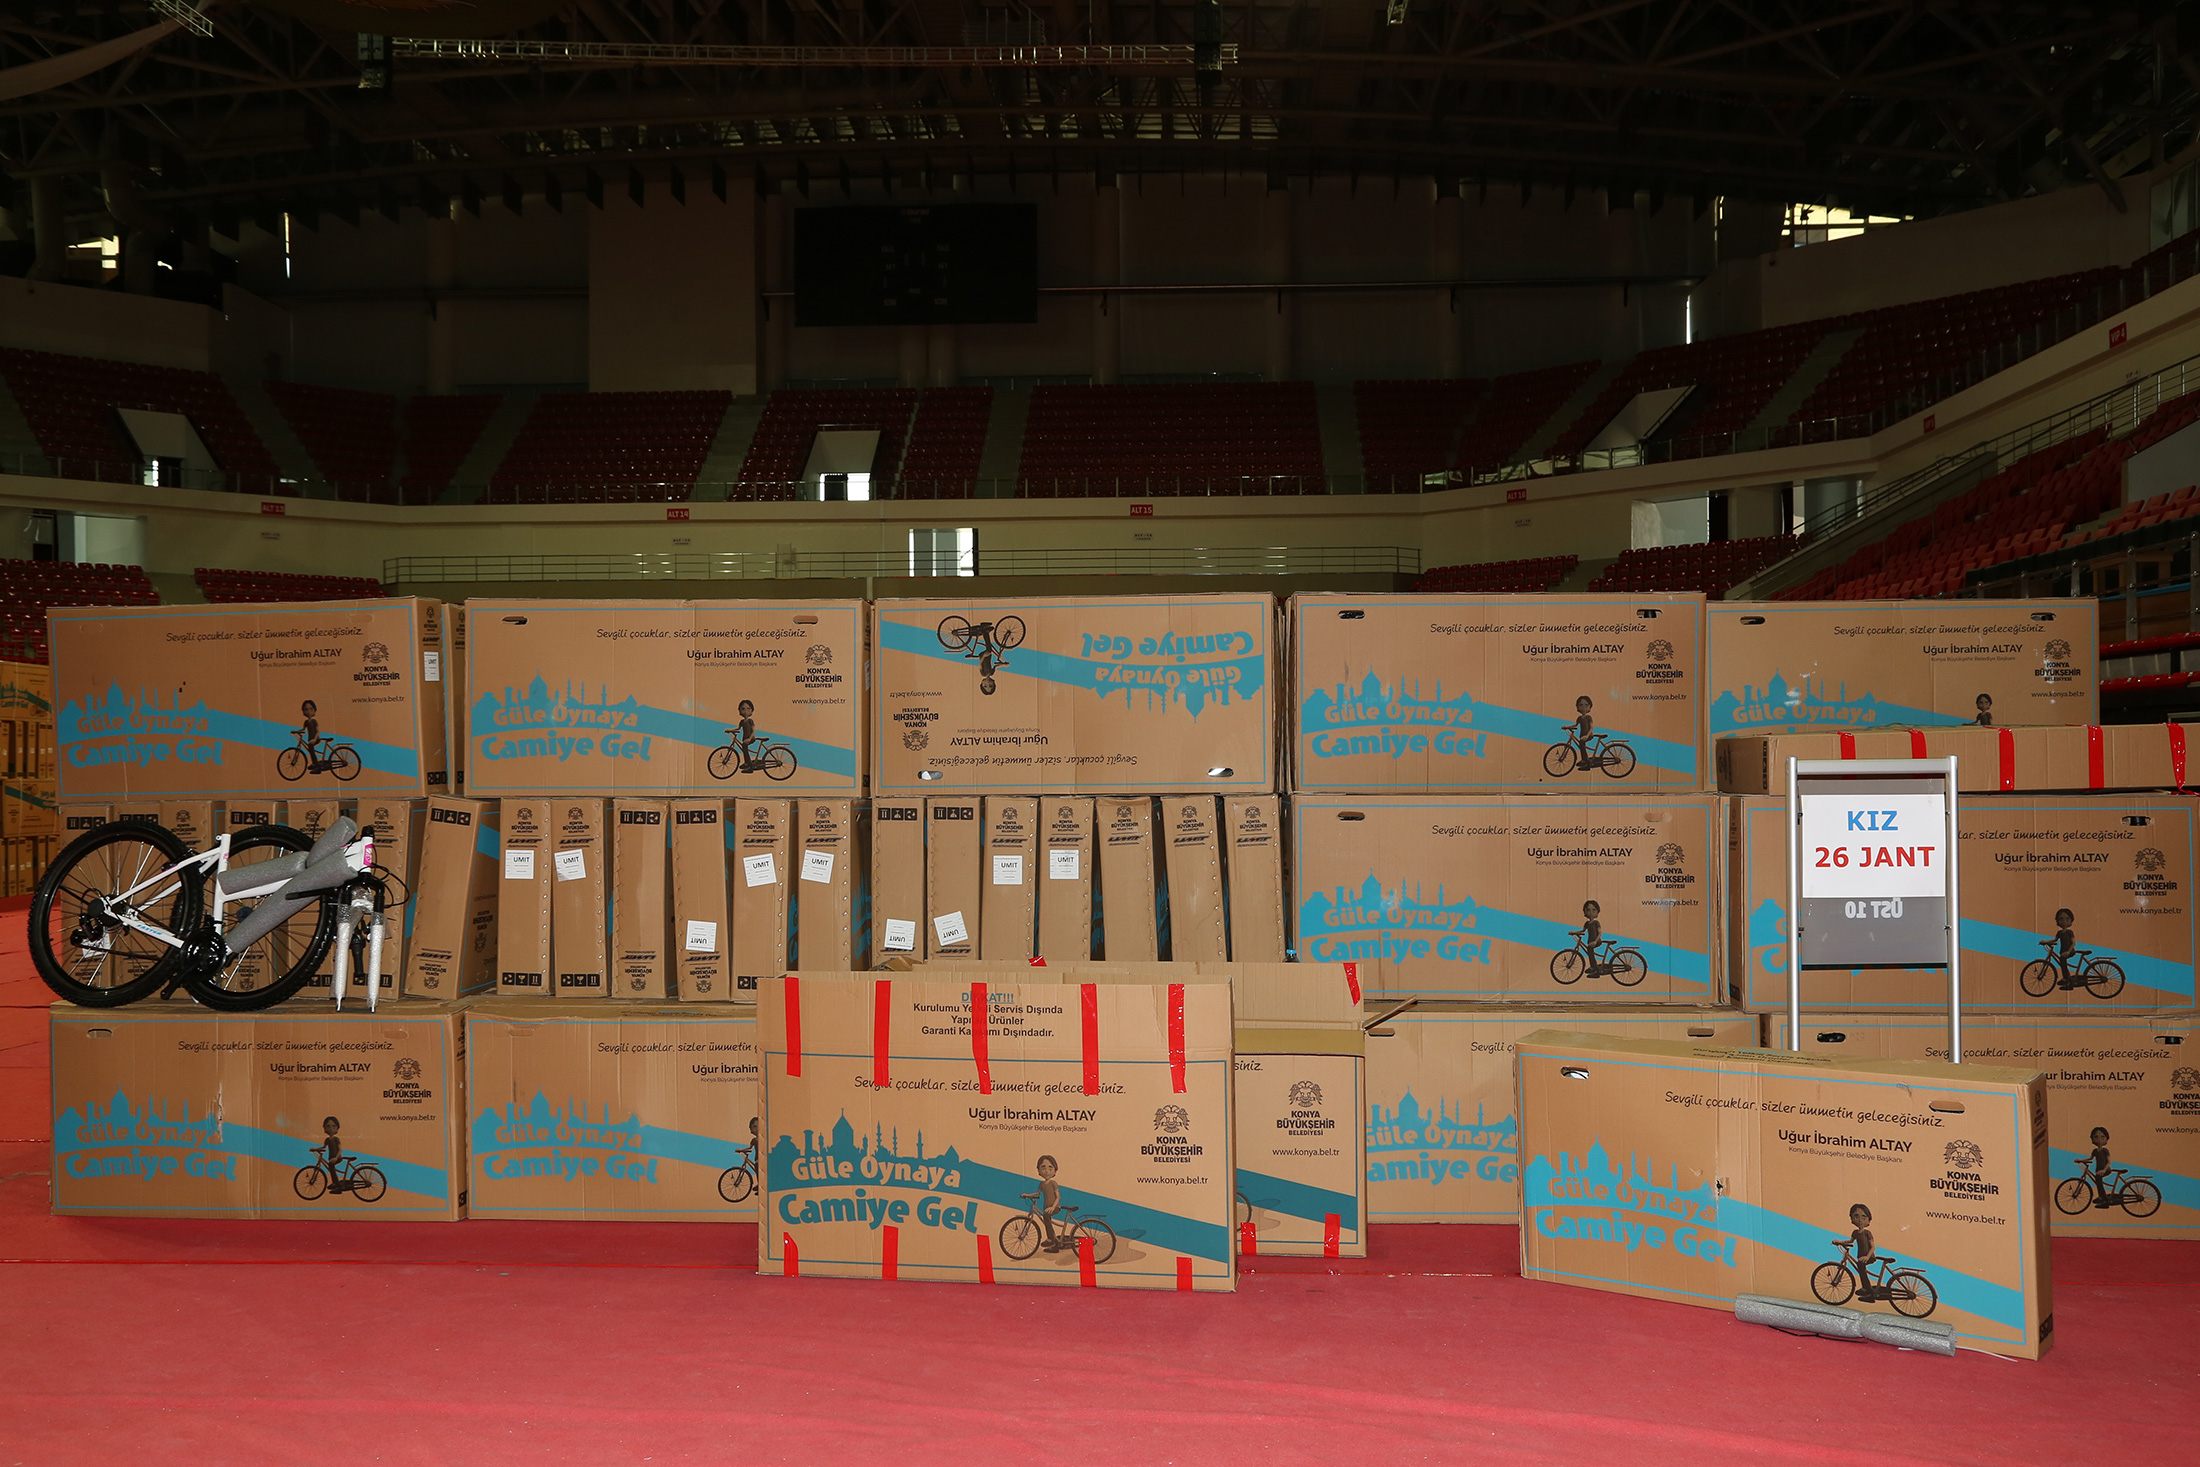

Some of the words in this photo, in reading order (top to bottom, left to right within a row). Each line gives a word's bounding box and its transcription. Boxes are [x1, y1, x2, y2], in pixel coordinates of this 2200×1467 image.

[668, 510, 679, 518] ALT
[1131, 506, 1142, 514] ALT
[1143, 506, 1152, 514] 15
[1431, 624, 1462, 634] Sevgili
[1464, 624, 1506, 635] çocuklar.
[1509, 624, 1537, 633] sizler
[1539, 624, 1581, 633] ümmetin
[1584, 624, 1648, 635] geleceğisiniz.
[1080, 631, 1132, 660] Gel
[1138, 629, 1253, 663] Camiye
[1522, 645, 1548, 655] Uğur
[1550, 643, 1590, 654] İbrahim
[1593, 645, 1624, 654] ALTAY
[1923, 645, 1948, 655] Uğur
[1950, 643, 1989, 654] İbrahim
[1992, 644, 2023, 653] ALTAY
[250, 650, 274, 661] Uğur
[275, 647, 312, 659] İbrahim
[314, 648, 343, 658] ALTAY
[686, 649, 711, 659] Uğur
[713, 648, 751, 658] İbrahim
[754, 650, 784, 658] ALTAY
[796, 674, 842, 683] BÜYÜKŞEHİR
[1094, 664, 1180, 689] Oynaya
[1186, 665, 1241, 687] Güle
[1636, 670, 1683, 679] BÜYÜKŞEHİR
[493, 705, 547, 726] Güle
[552, 705, 638, 728] Oynaya
[893, 712, 938, 721] BÜYÜKŞEHİR
[1325, 702, 1380, 723] Güle
[1386, 702, 1473, 725] Oynaya
[1732, 703, 1786, 723] Güle
[1792, 702, 1876, 723] Oynaya
[77, 713, 124, 733] Güle
[129, 712, 208, 733] Oynaya
[480, 730, 594, 762] Camiye
[600, 733, 652, 761] Gel
[950, 736, 980, 745] ALTAY
[982, 736, 1021, 747] İbrahim
[1023, 735, 1048, 745] Uğur
[1312, 727, 1428, 759] Camiye
[1434, 730, 1487, 758] Gel
[68, 736, 171, 767] Camiye
[176, 739, 223, 765] Gel
[1848, 811, 1898, 830] KIZ
[1527, 847, 1554, 858] Uğur
[1556, 846, 1598, 857] İbrahim
[1600, 848, 1633, 857] ALTAY
[1816, 847, 1849, 867] 26
[1860, 847, 1935, 867] JANT
[1994, 853, 2023, 864] Uğur
[2026, 851, 2071, 863] İbrahim
[2074, 853, 2109, 863] ALTAY
[1645, 874, 1695, 884] BÜYÜKŞEHİR
[2123, 881, 2178, 891] BÜYÜKŞEHİR
[1641, 899, 1698, 907] www.konya.bel.tr
[1324, 905, 1380, 927] Güle
[1387, 905, 1477, 930] Oynaya
[2119, 907, 2182, 916] www.konya.bel.tr
[1310, 930, 1431, 965] Camiye
[1437, 935, 1491, 964] Gel
[914, 1003, 959, 1012] Kurulumu
[994, 1005, 1023, 1014] Servis
[1026, 1005, 1062, 1016] Dışında
[989, 1016, 1024, 1025] Ürünler
[922, 1027, 956, 1036] Garanti
[1003, 1028, 1054, 1037] Dışındadır.
[269, 1063, 295, 1074] Uğur
[297, 1061, 337, 1073] İbrahim
[339, 1063, 371, 1072] ALTAY
[2061, 1069, 2105, 1081] İbrahim
[2109, 1072, 2145, 1081] ALTAY
[896, 1079, 948, 1092] çocuklar.
[951, 1081, 980, 1092] sizle
[990, 1081, 1041, 1093] ümmetin
[968, 1108, 1000, 1122] Uğur
[1003, 1106, 1053, 1121] İbrahim
[1056, 1110, 1096, 1121] ALTAY
[1666, 1091, 1702, 1107] Sevgili
[1706, 1097, 1758, 1111] çocuklar.
[1761, 1101, 1796, 1114] sizler
[1799, 1104, 1853, 1119] ümmetin
[1857, 1110, 1945, 1128] geleceğisiniz.
[979, 1123, 997, 1131] Konya
[999, 1123, 1033, 1132] Büyükşehir
[1276, 1120, 1335, 1130] BÜYÜKŞEHİR
[76, 1123, 129, 1143] Güle
[135, 1122, 221, 1147] Oynaya
[495, 1125, 550, 1144] Güle
[556, 1123, 642, 1149] Oynaya
[1156, 1136, 1187, 1144] KONYA
[1425, 1125, 1517, 1150] Oynaya
[1779, 1130, 1810, 1144] Uğur
[1814, 1131, 1866, 1148] İbrahim
[1870, 1138, 1912, 1153] ALTAY
[1141, 1145, 1203, 1156] BÜYÜKŞEHİR
[1273, 1148, 1340, 1156] www.konya.bel.tr
[65, 1148, 178, 1181] Camiye
[184, 1152, 237, 1181] Gel
[483, 1149, 600, 1182] Camiye
[605, 1155, 658, 1184] Gel
[1367, 1152, 1469, 1185] amiye
[1476, 1156, 1518, 1183] Ge
[791, 1156, 853, 1180] Güle
[860, 1155, 961, 1190] Oynaya
[1947, 1171, 1981, 1182] KONYA
[1137, 1177, 1208, 1185] www.konya.bel.tr
[1930, 1179, 1999, 1195] BÜYÜKŞEHİR
[1548, 1177, 1609, 1200] Güle
[1616, 1182, 1717, 1222] Oynaya
[1944, 1192, 1985, 1201] BELEDİYESİ
[779, 1188, 910, 1230] Camiye
[917, 1196, 978, 1234] Gel
[1926, 1210, 2005, 1226] www.konya.bel.tr
[1536, 1209, 1666, 1252] Camiye
[1673, 1227, 1737, 1268] Gel
